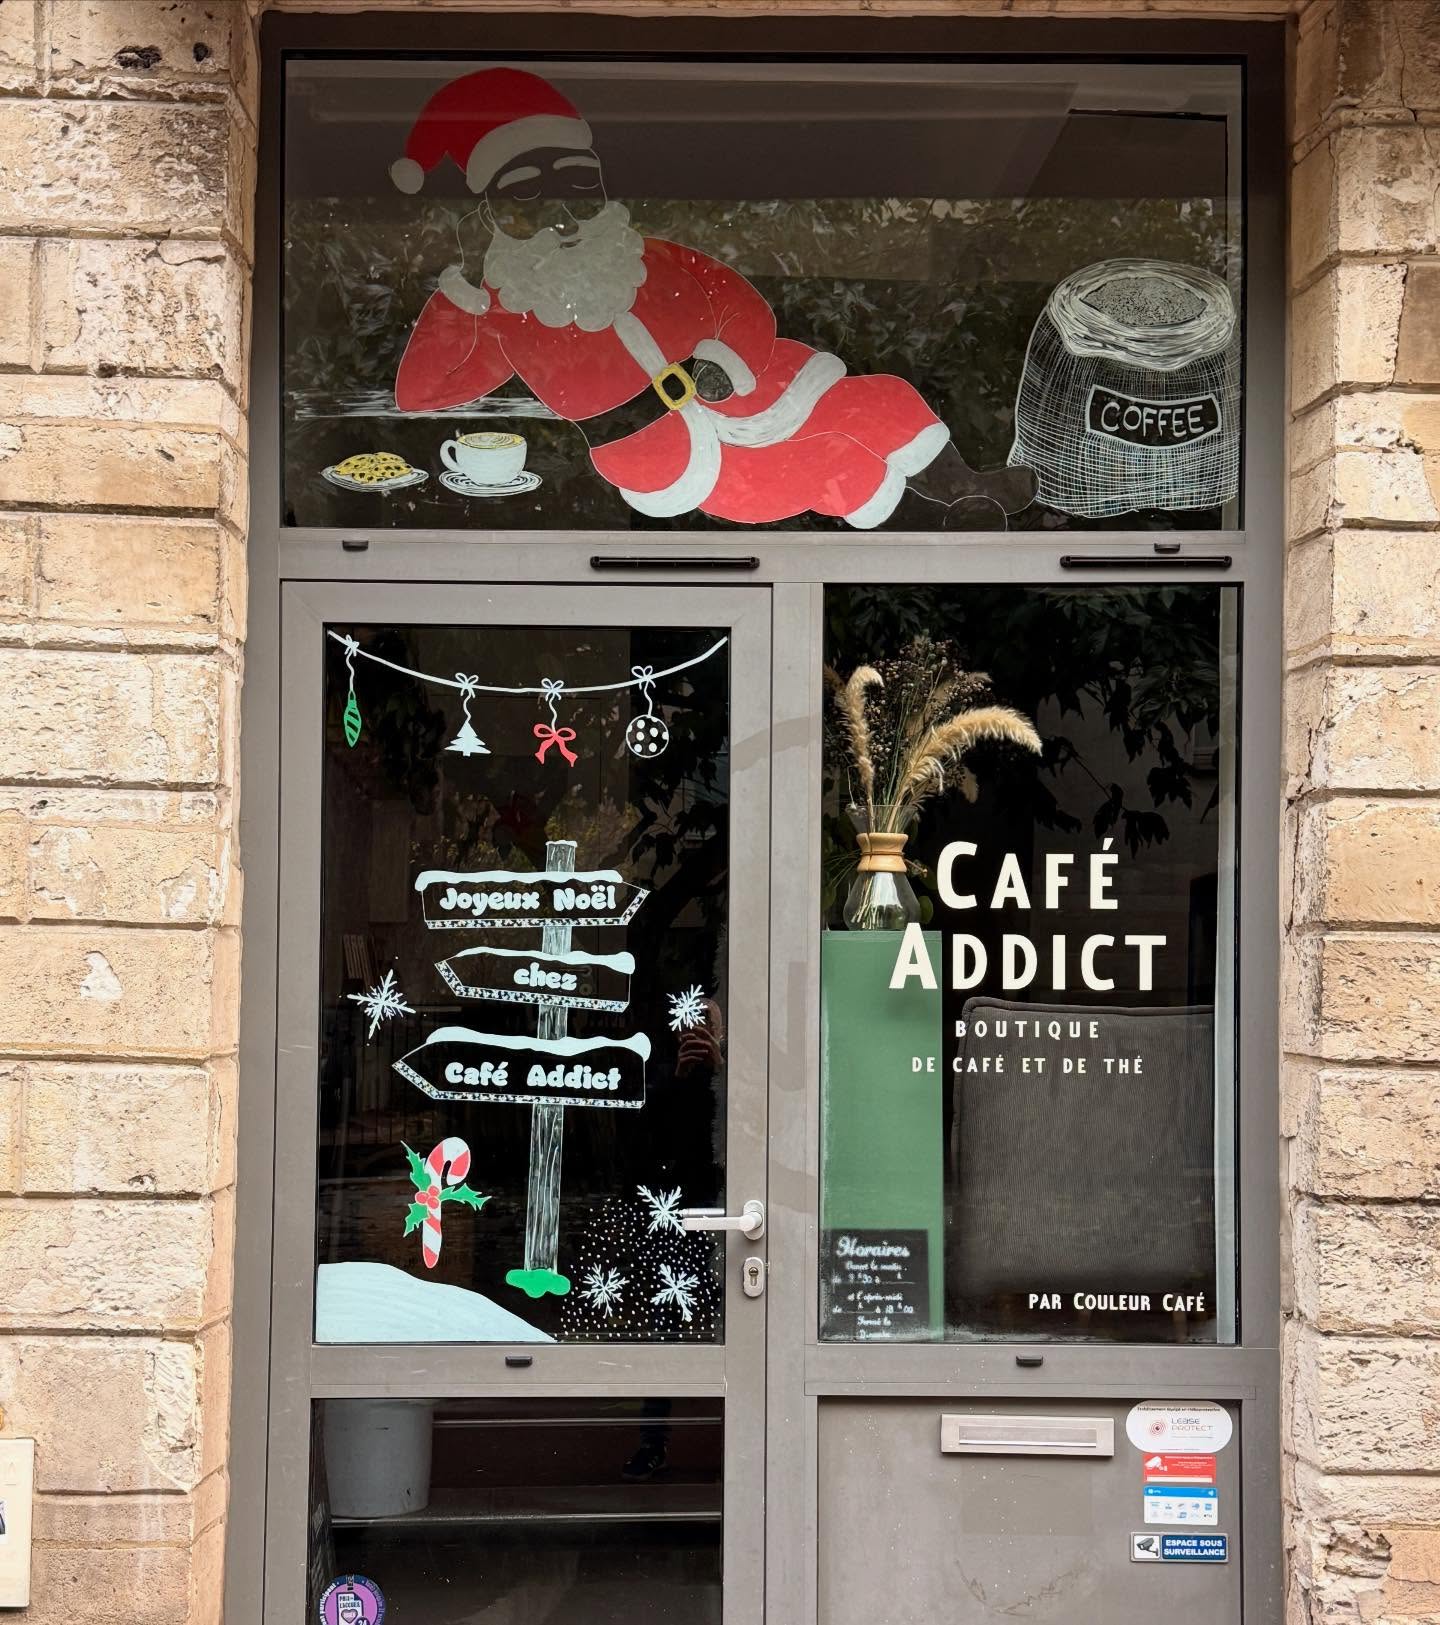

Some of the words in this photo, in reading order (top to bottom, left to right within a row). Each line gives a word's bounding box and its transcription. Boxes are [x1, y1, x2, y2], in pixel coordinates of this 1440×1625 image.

[1101, 401, 1204, 437] COFFEE
[938, 837, 1119, 909] CAFÉ
[439, 888, 540, 916] Joyeux
[553, 884, 616, 911] Noël
[888, 922, 1167, 991] ADDICT
[513, 962, 577, 990] chez
[955, 1020, 1100, 1041] BOUTIQUE
[444, 1061, 509, 1087] Café
[526, 1064, 622, 1091] Addict
[911, 1056, 936, 1073] DE
[952, 1054, 1004, 1073] CAFÉ
[1022, 1057, 1046, 1074] ET
[1063, 1057, 1087, 1074] DE
[1103, 1055, 1143, 1074] THÉ
[1028, 1293, 1062, 1310] PAR
[1073, 1292, 1151, 1311] COULEUR
[1162, 1291, 1206, 1312] CAFÉ
[1163, 1548, 1226, 1556] SURVEILLANCE
[1165, 1539, 1197, 1547] ESPACE
